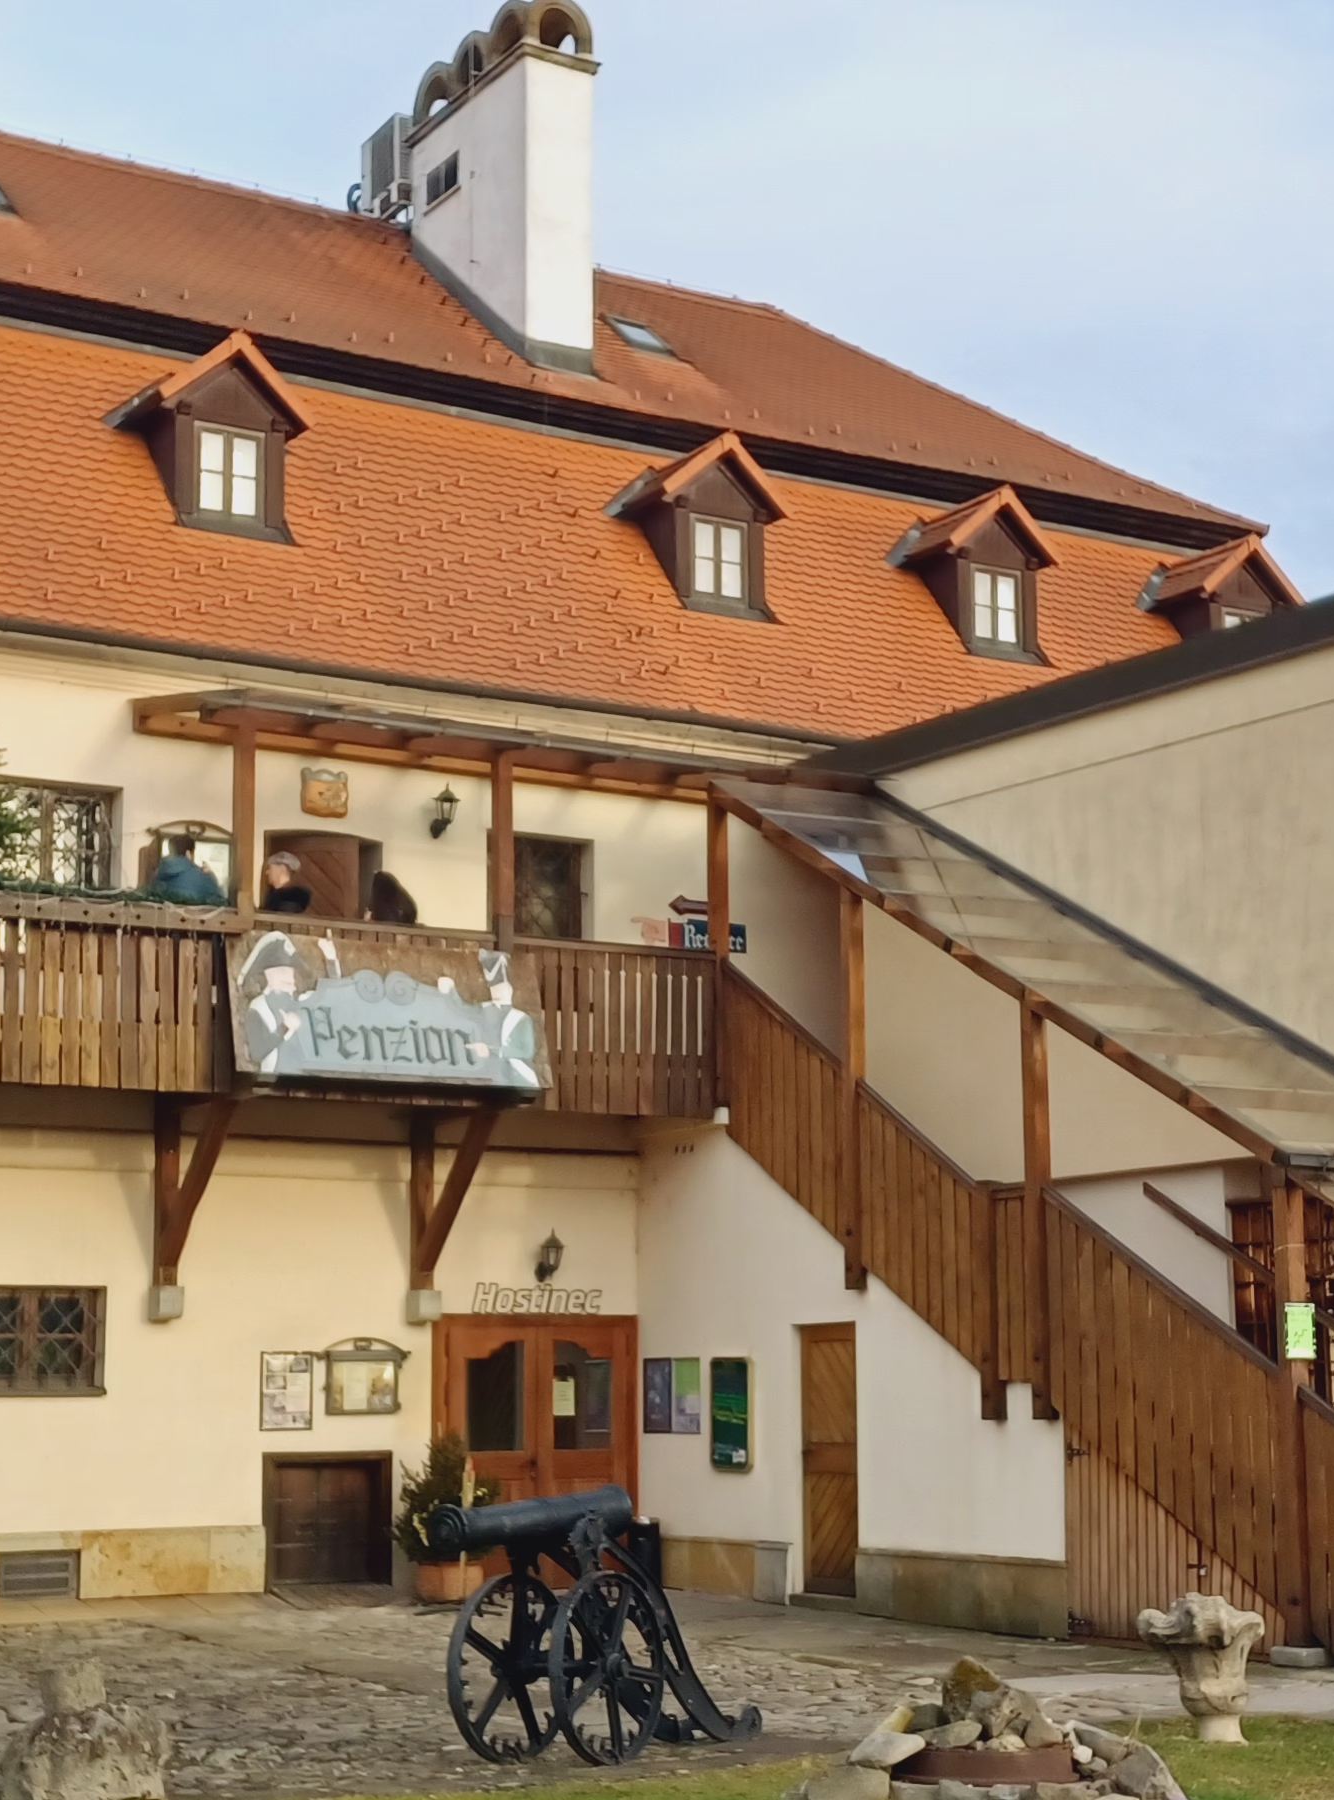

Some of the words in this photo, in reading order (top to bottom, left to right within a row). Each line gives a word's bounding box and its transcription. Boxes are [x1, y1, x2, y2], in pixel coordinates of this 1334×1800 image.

[683, 923, 744, 951] Recce
[301, 1005, 478, 1067] Penzion
[471, 1281, 603, 1315] Hostinec
